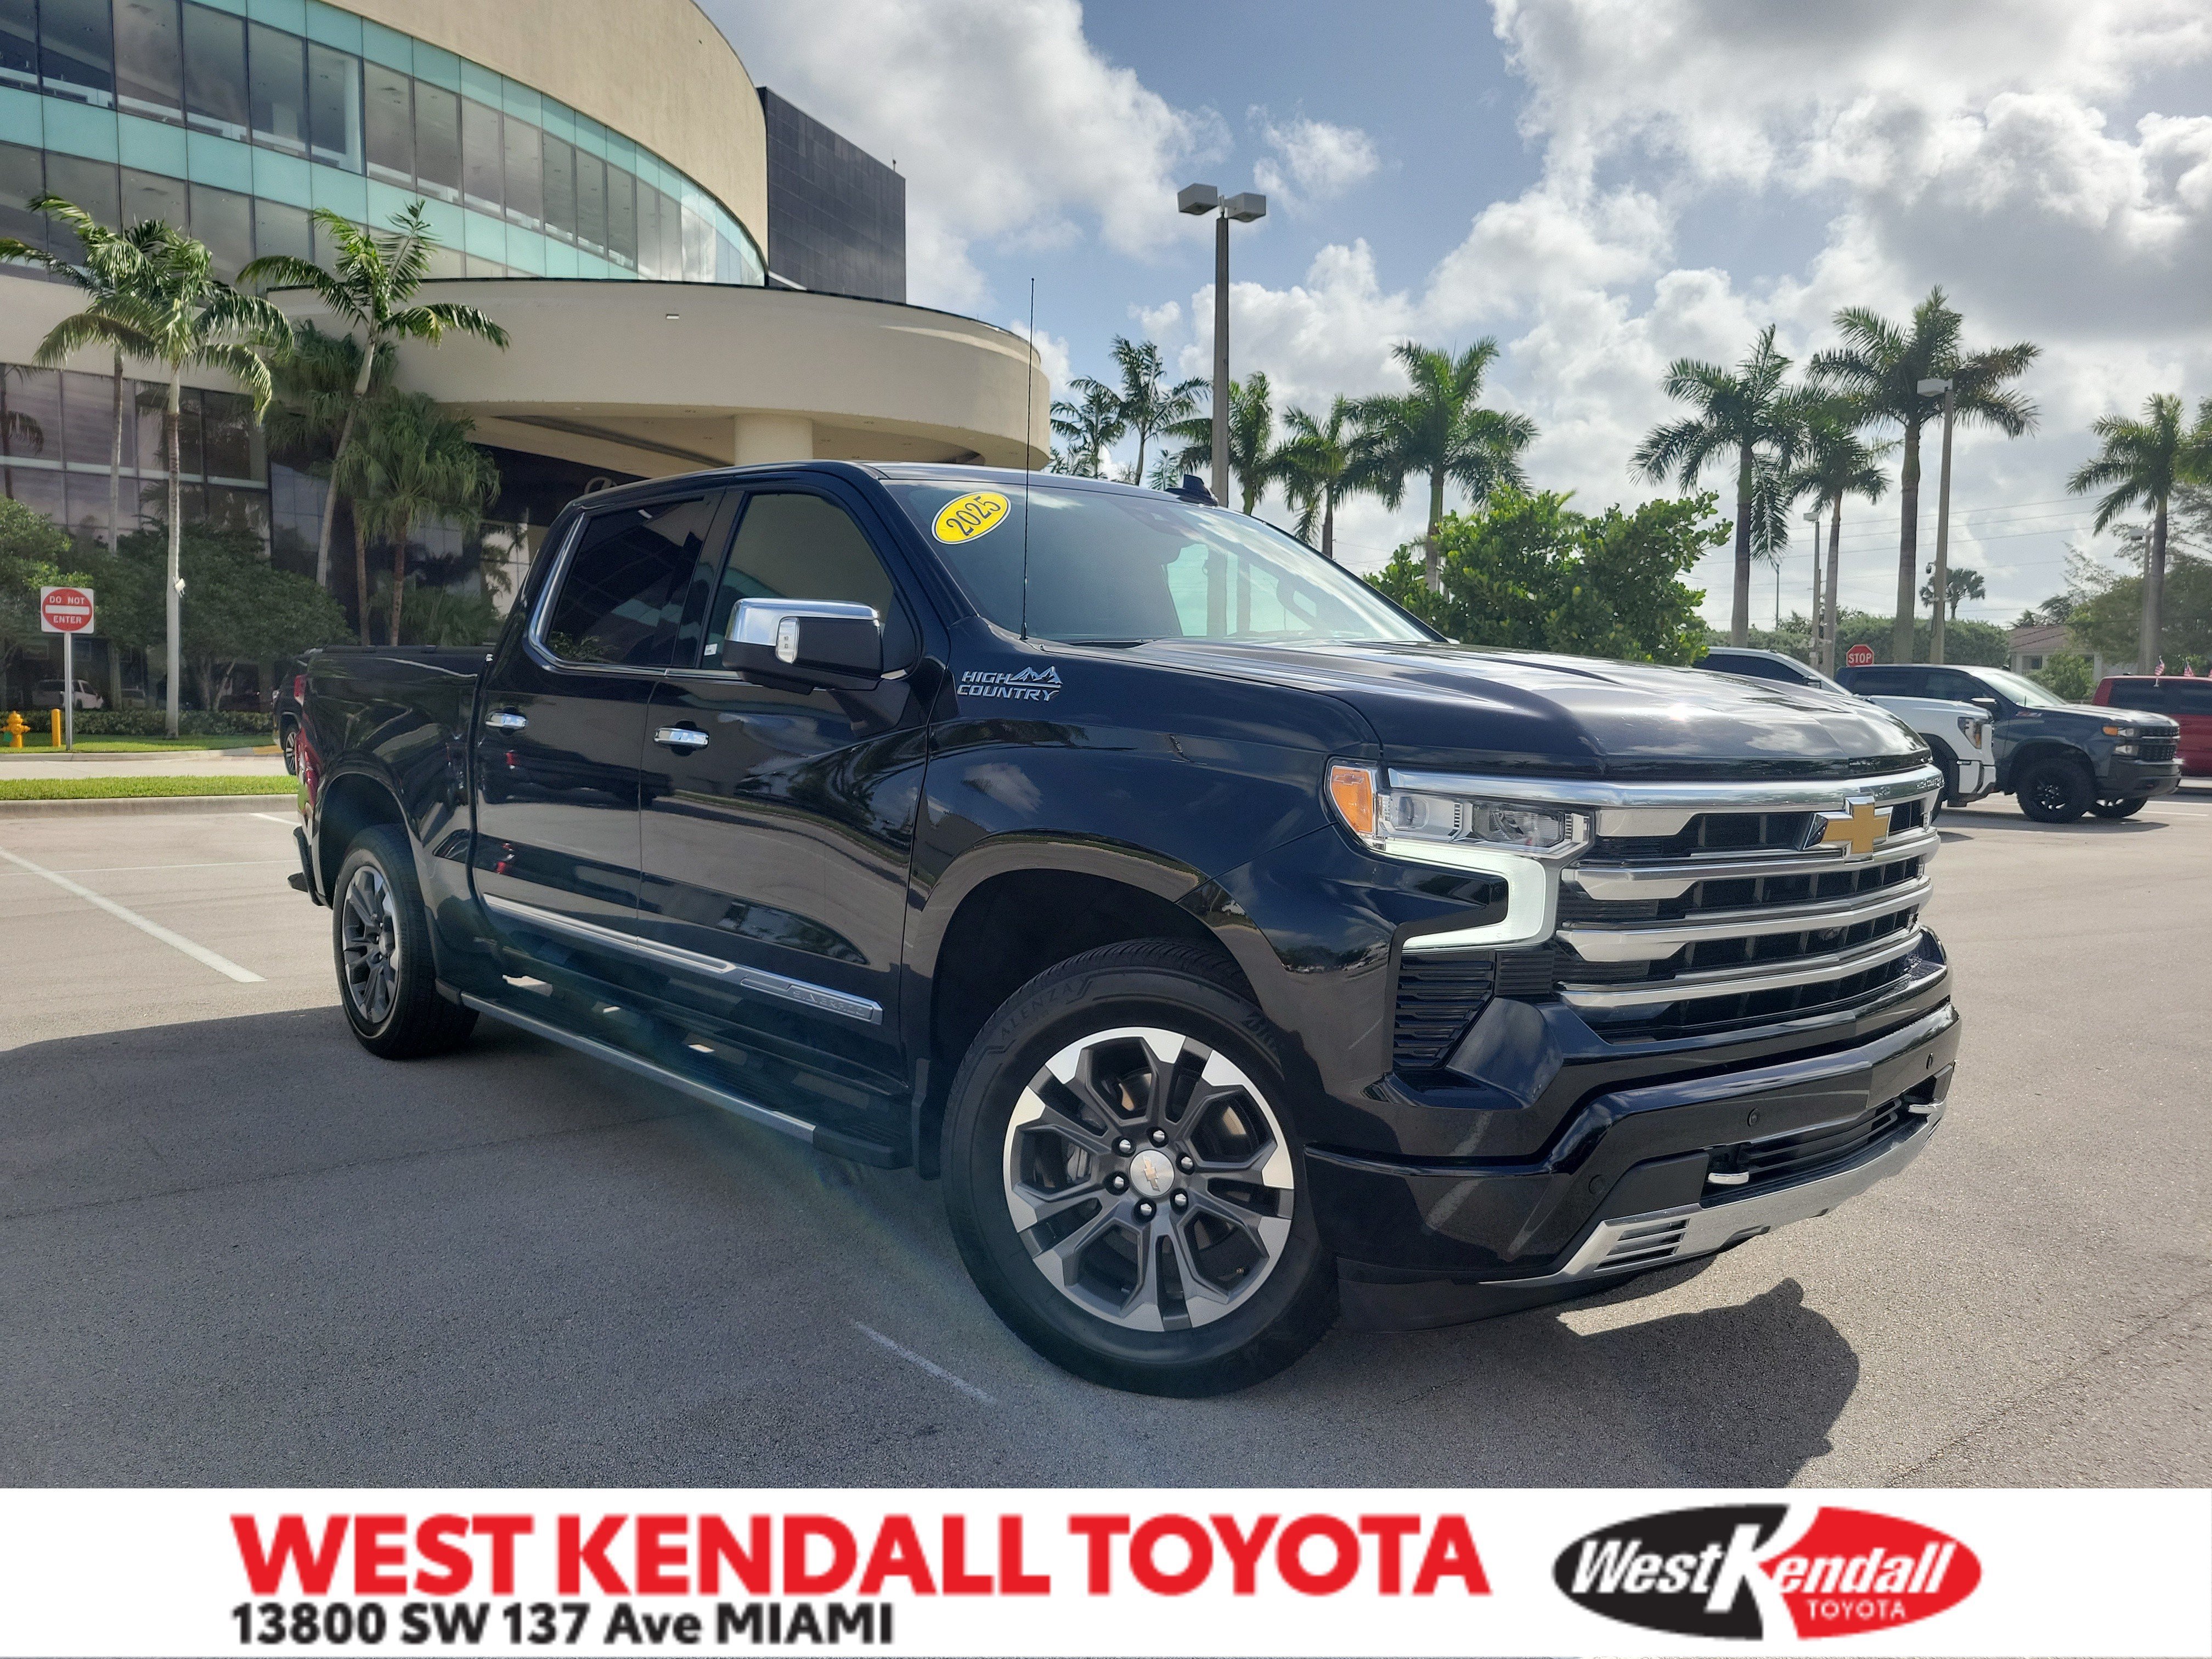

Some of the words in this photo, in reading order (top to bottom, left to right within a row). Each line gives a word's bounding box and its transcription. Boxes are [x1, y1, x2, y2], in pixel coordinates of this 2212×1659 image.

[946, 496, 1001, 536] 2025
[68, 596, 85, 605] NOT
[53, 616, 81, 624] ENTER
[1848, 653, 1872, 664] STOP
[961, 671, 1013, 684] HIGH
[957, 685, 1059, 702] COUNTRY
